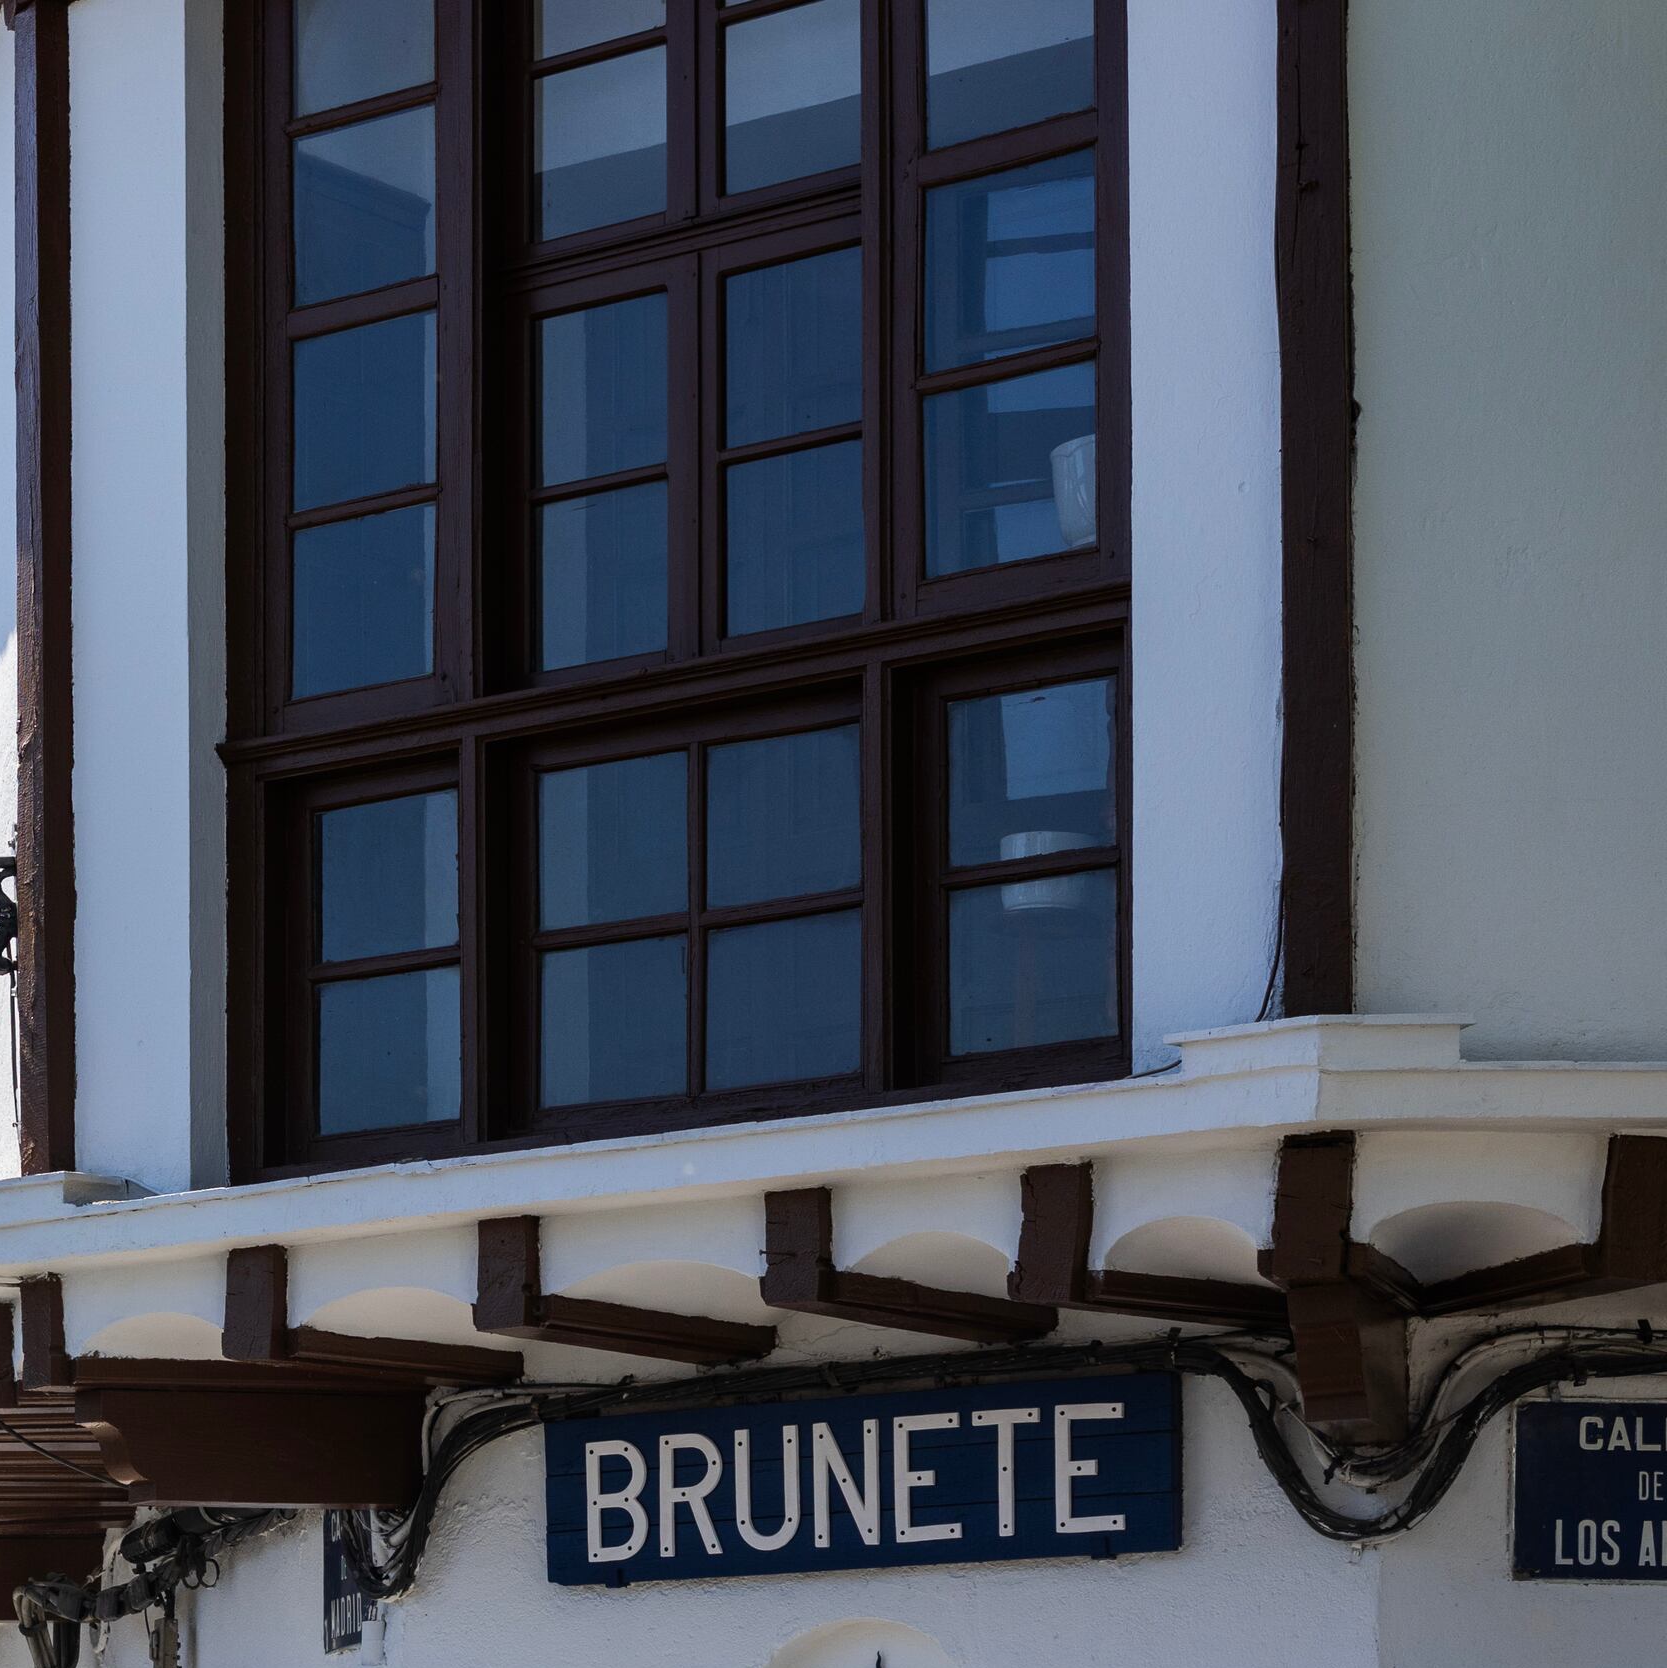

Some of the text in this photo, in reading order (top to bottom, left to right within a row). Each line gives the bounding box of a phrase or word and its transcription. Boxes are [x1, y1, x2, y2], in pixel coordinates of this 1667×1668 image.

[1578, 1415, 1667, 1451] CAL
[585, 1402, 1126, 1564] BRUNETE
[1638, 1471, 1664, 1500] DE
[1555, 1519, 1620, 1566] LOS
[330, 1592, 362, 1639] MADRID
